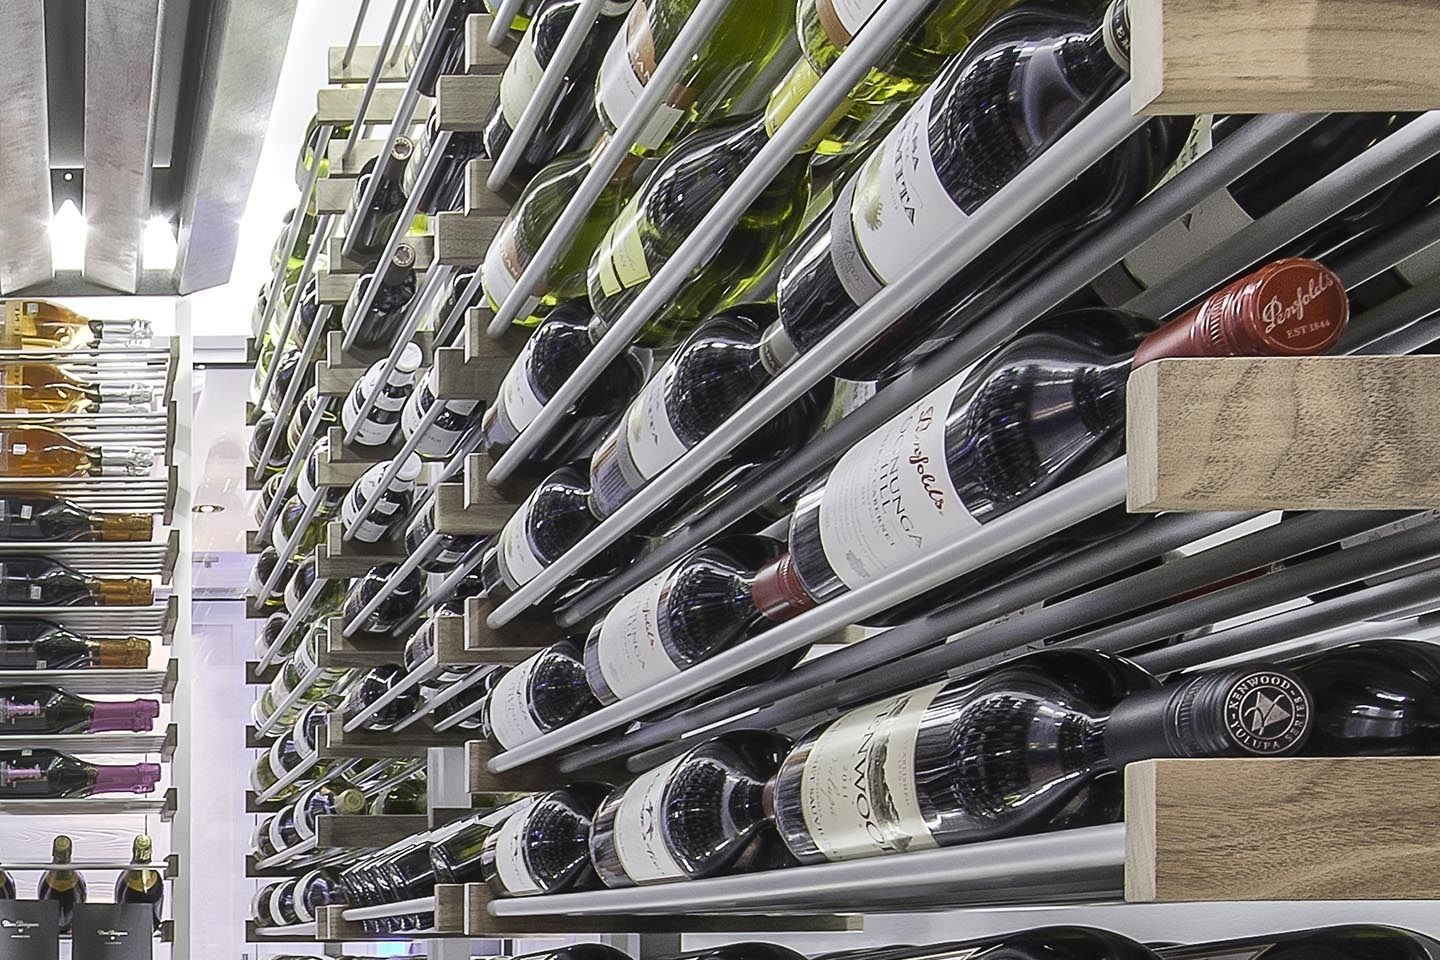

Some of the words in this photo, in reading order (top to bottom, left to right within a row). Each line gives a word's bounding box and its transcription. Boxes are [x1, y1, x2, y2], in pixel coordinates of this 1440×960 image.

[1262, 271, 1334, 334] Penfolds
[1286, 326, 1308, 339] EST
[1309, 320, 1330, 332] 1844
[1229, 675, 1291, 710] KENWOOD
